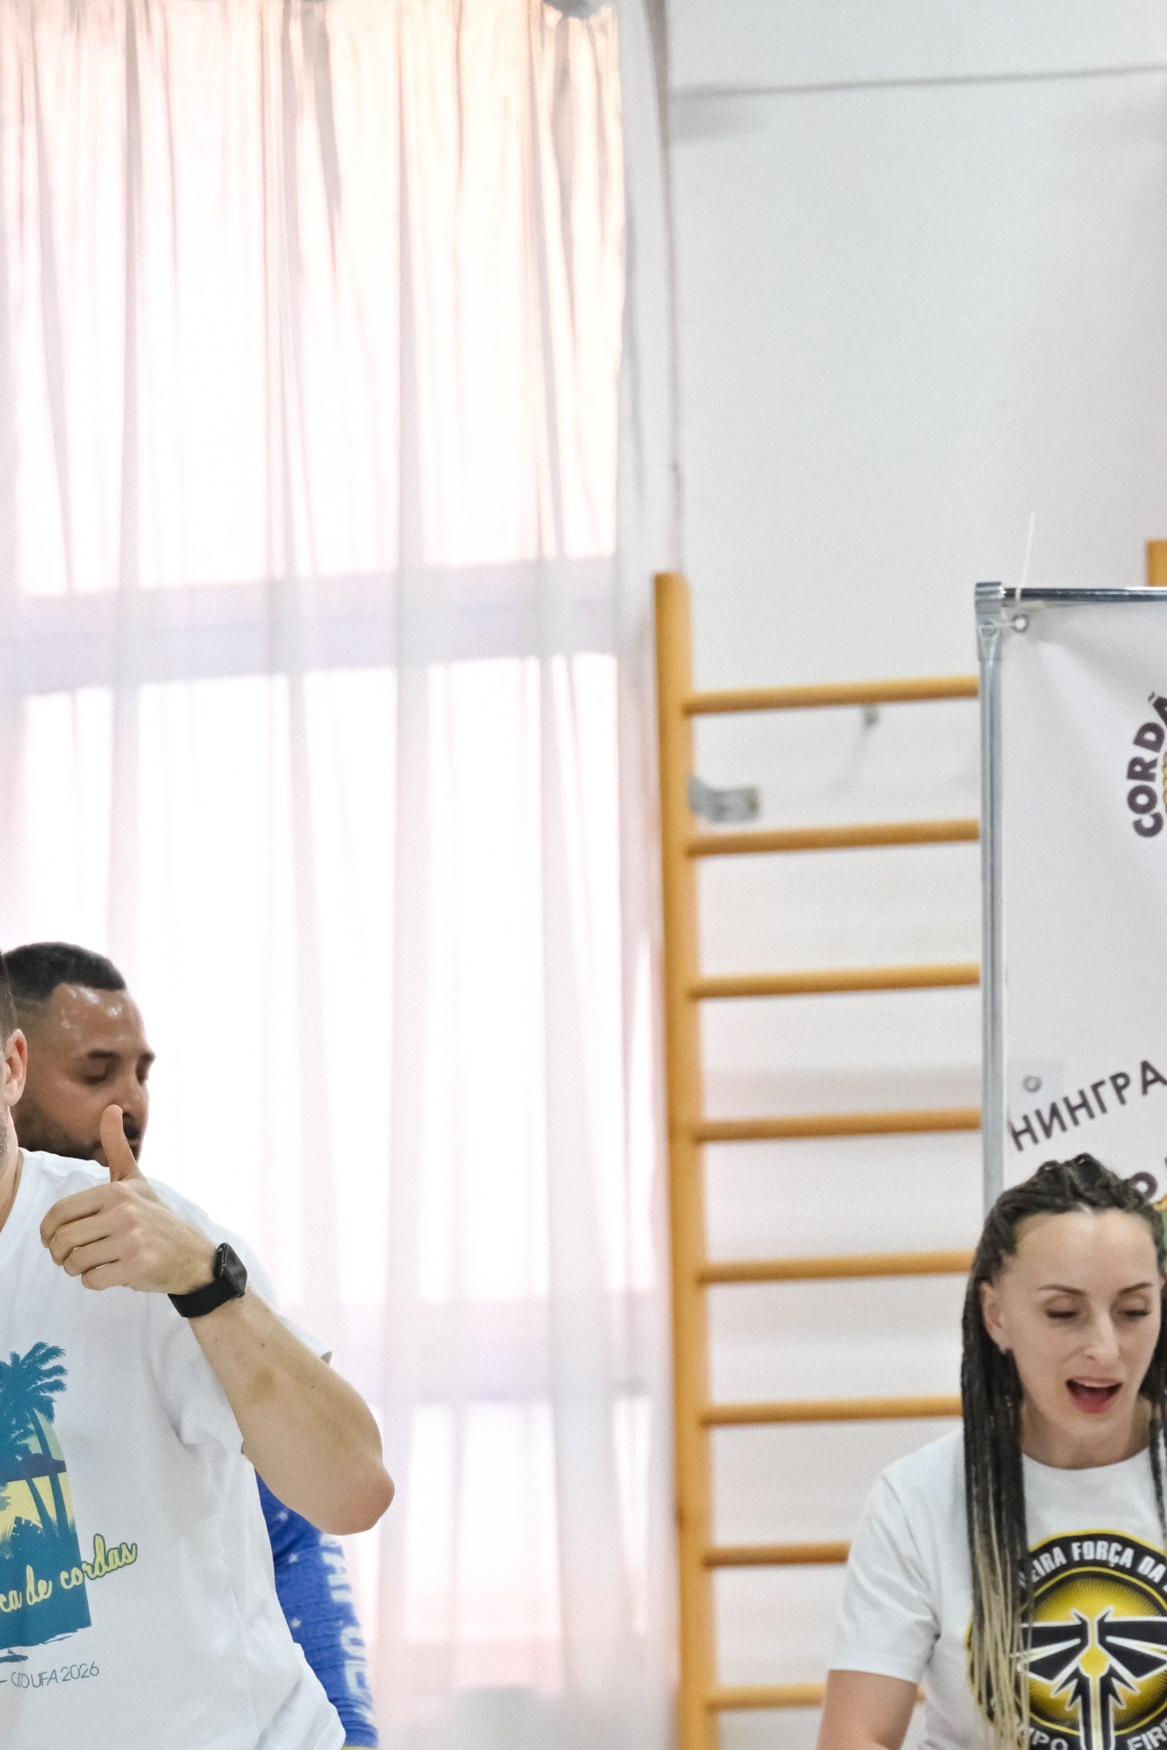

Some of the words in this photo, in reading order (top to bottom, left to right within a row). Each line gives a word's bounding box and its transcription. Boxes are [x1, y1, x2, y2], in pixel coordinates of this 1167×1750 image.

[26, 1565, 52, 1606] de
[60, 1533, 138, 1590] cordas
[1072, 1540, 1134, 1568] FORÇA
[1137, 1555, 1167, 1583] DA
[31, 1669, 59, 1688] UFA
[61, 1661, 100, 1682] 2026
